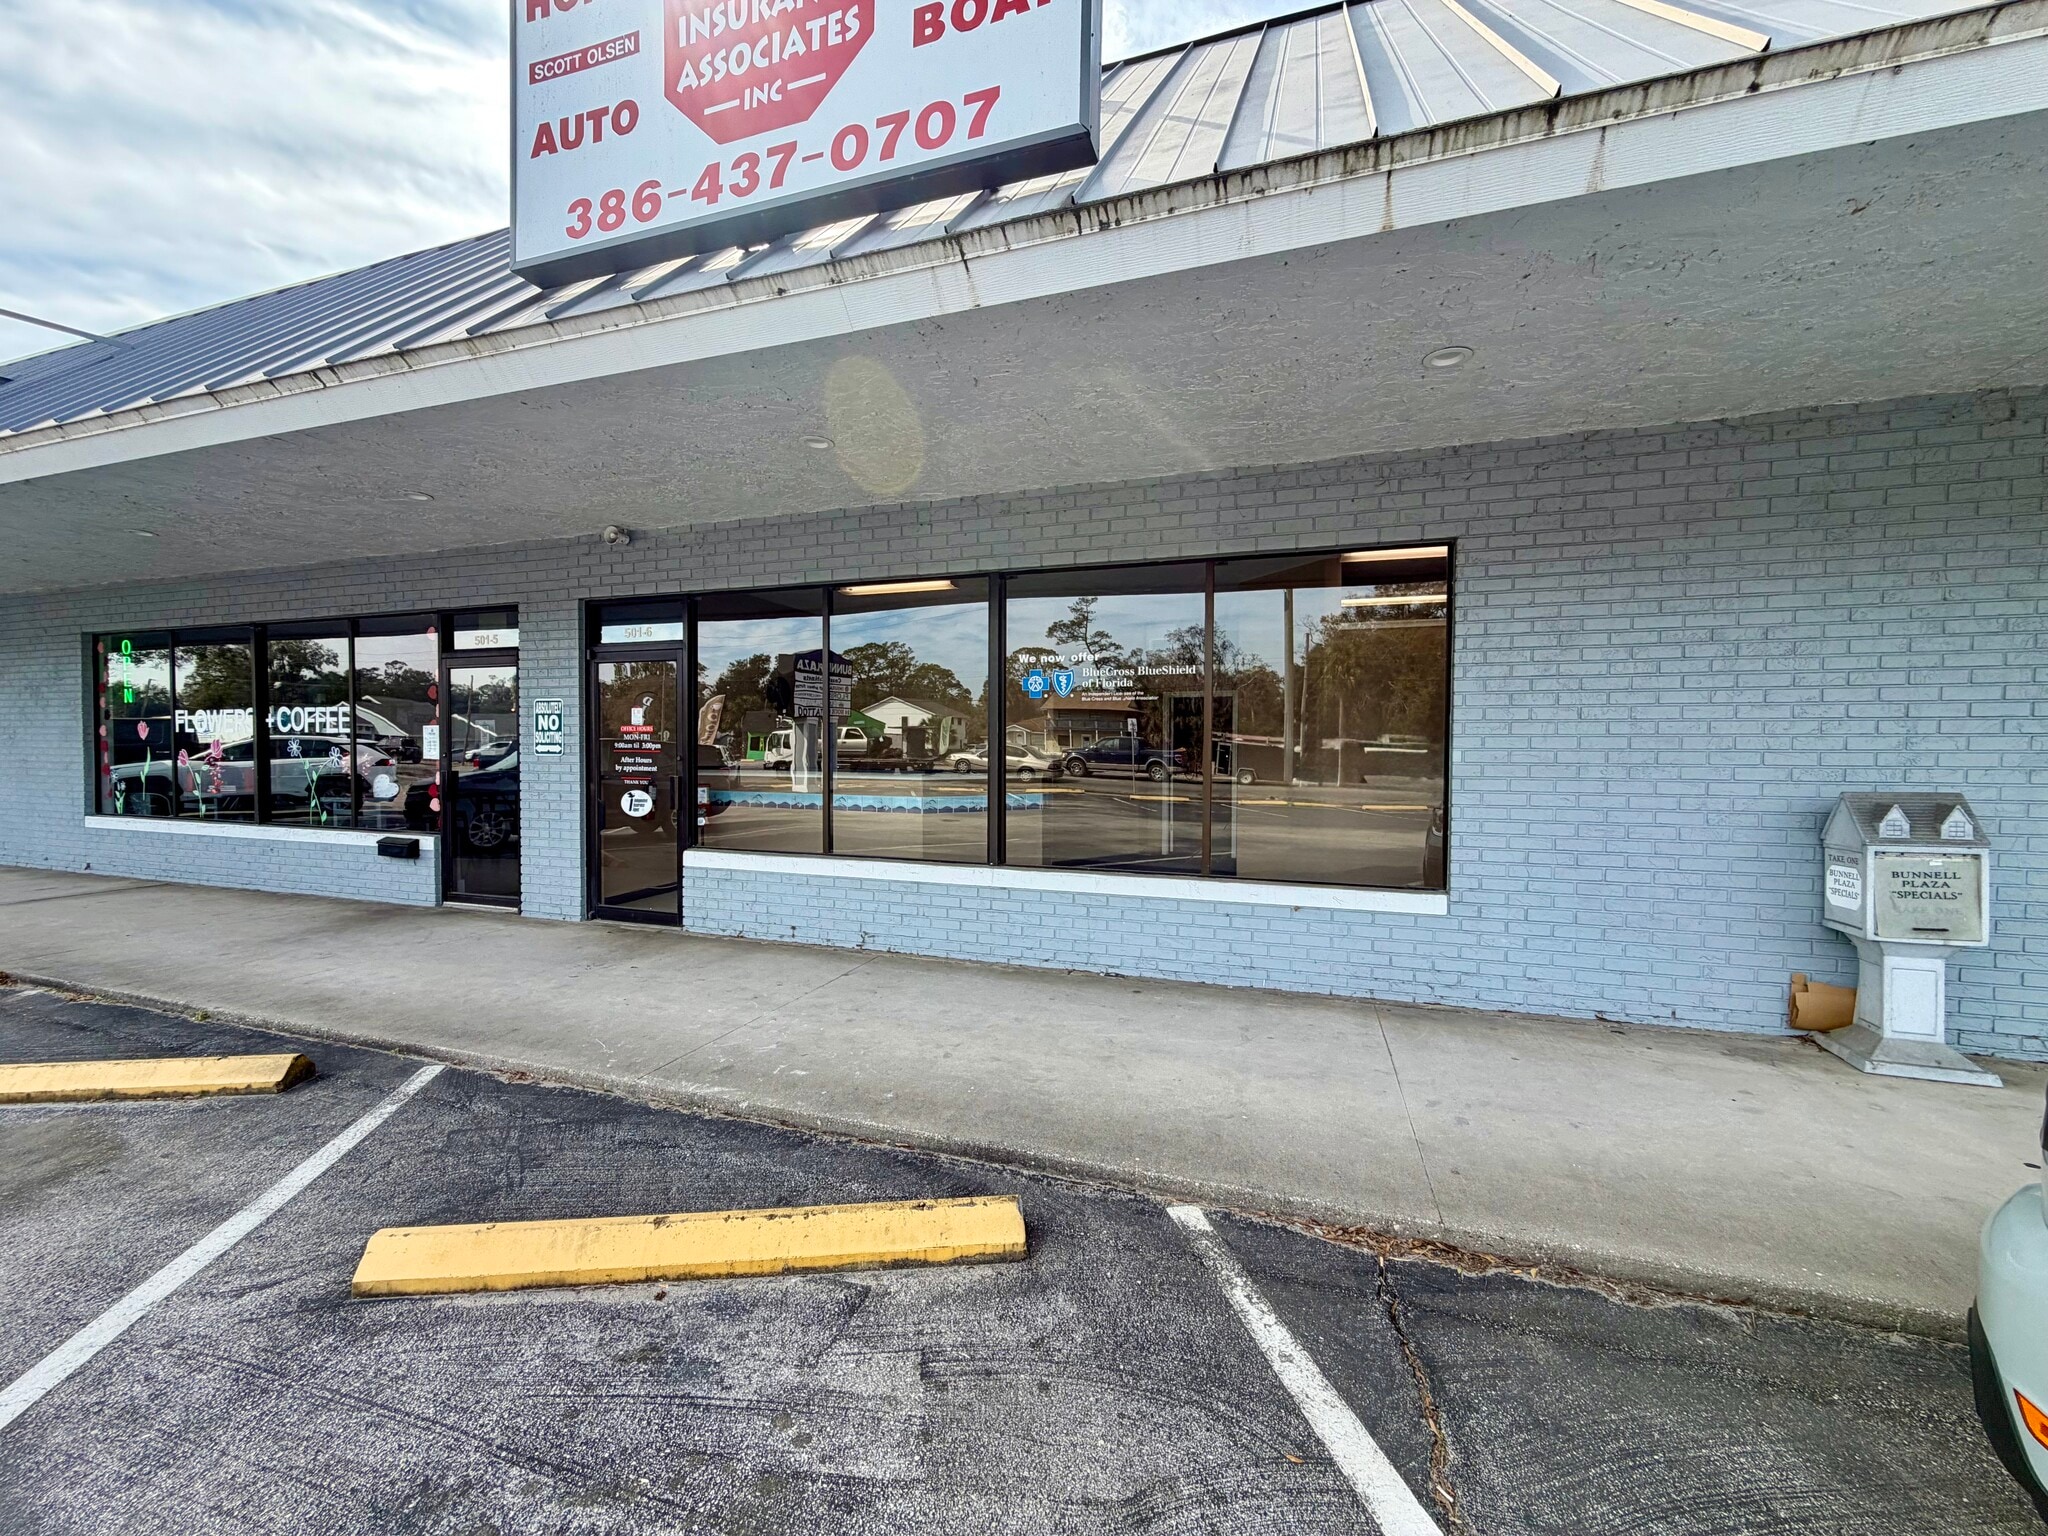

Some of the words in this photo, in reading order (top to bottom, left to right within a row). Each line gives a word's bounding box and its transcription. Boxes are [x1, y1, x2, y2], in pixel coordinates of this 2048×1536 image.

[913, 0, 1052, 48] BOA
[676, 5, 861, 94] ASSOCIATES
[534, 53, 582, 80] SCOTT
[587, 36, 635, 64] OLSEN
[744, 78, 783, 110] INC
[530, 99, 640, 159] AUTO
[565, 85, 1001, 239] 386-437-0707
[624, 627, 653, 638] 501-6
[474, 634, 499, 646] 501-5
[1018, 654, 1036, 663] We
[1040, 655, 1065, 663] now
[1071, 652, 1101, 662] offer
[122, 640, 133, 703] OPEN
[1082, 667, 1135, 677] BlueCross
[1137, 665, 1196, 676] BlueShield
[1082, 679, 1093, 688] of
[1095, 678, 1133, 688] Florida
[538, 714, 559, 730] NO
[623, 733, 651, 741] MON-FRI
[615, 764, 622, 772] by
[623, 764, 658, 772] appointment
[1828, 854, 1845, 863] TAKE
[1846, 856, 1859, 865] ONE
[1829, 869, 1860, 881] BUNNELL
[1891, 871, 1962, 880] BUNNELL
[1833, 878, 1856, 889] PLAZA
[1902, 880, 1951, 889] PLAZA
